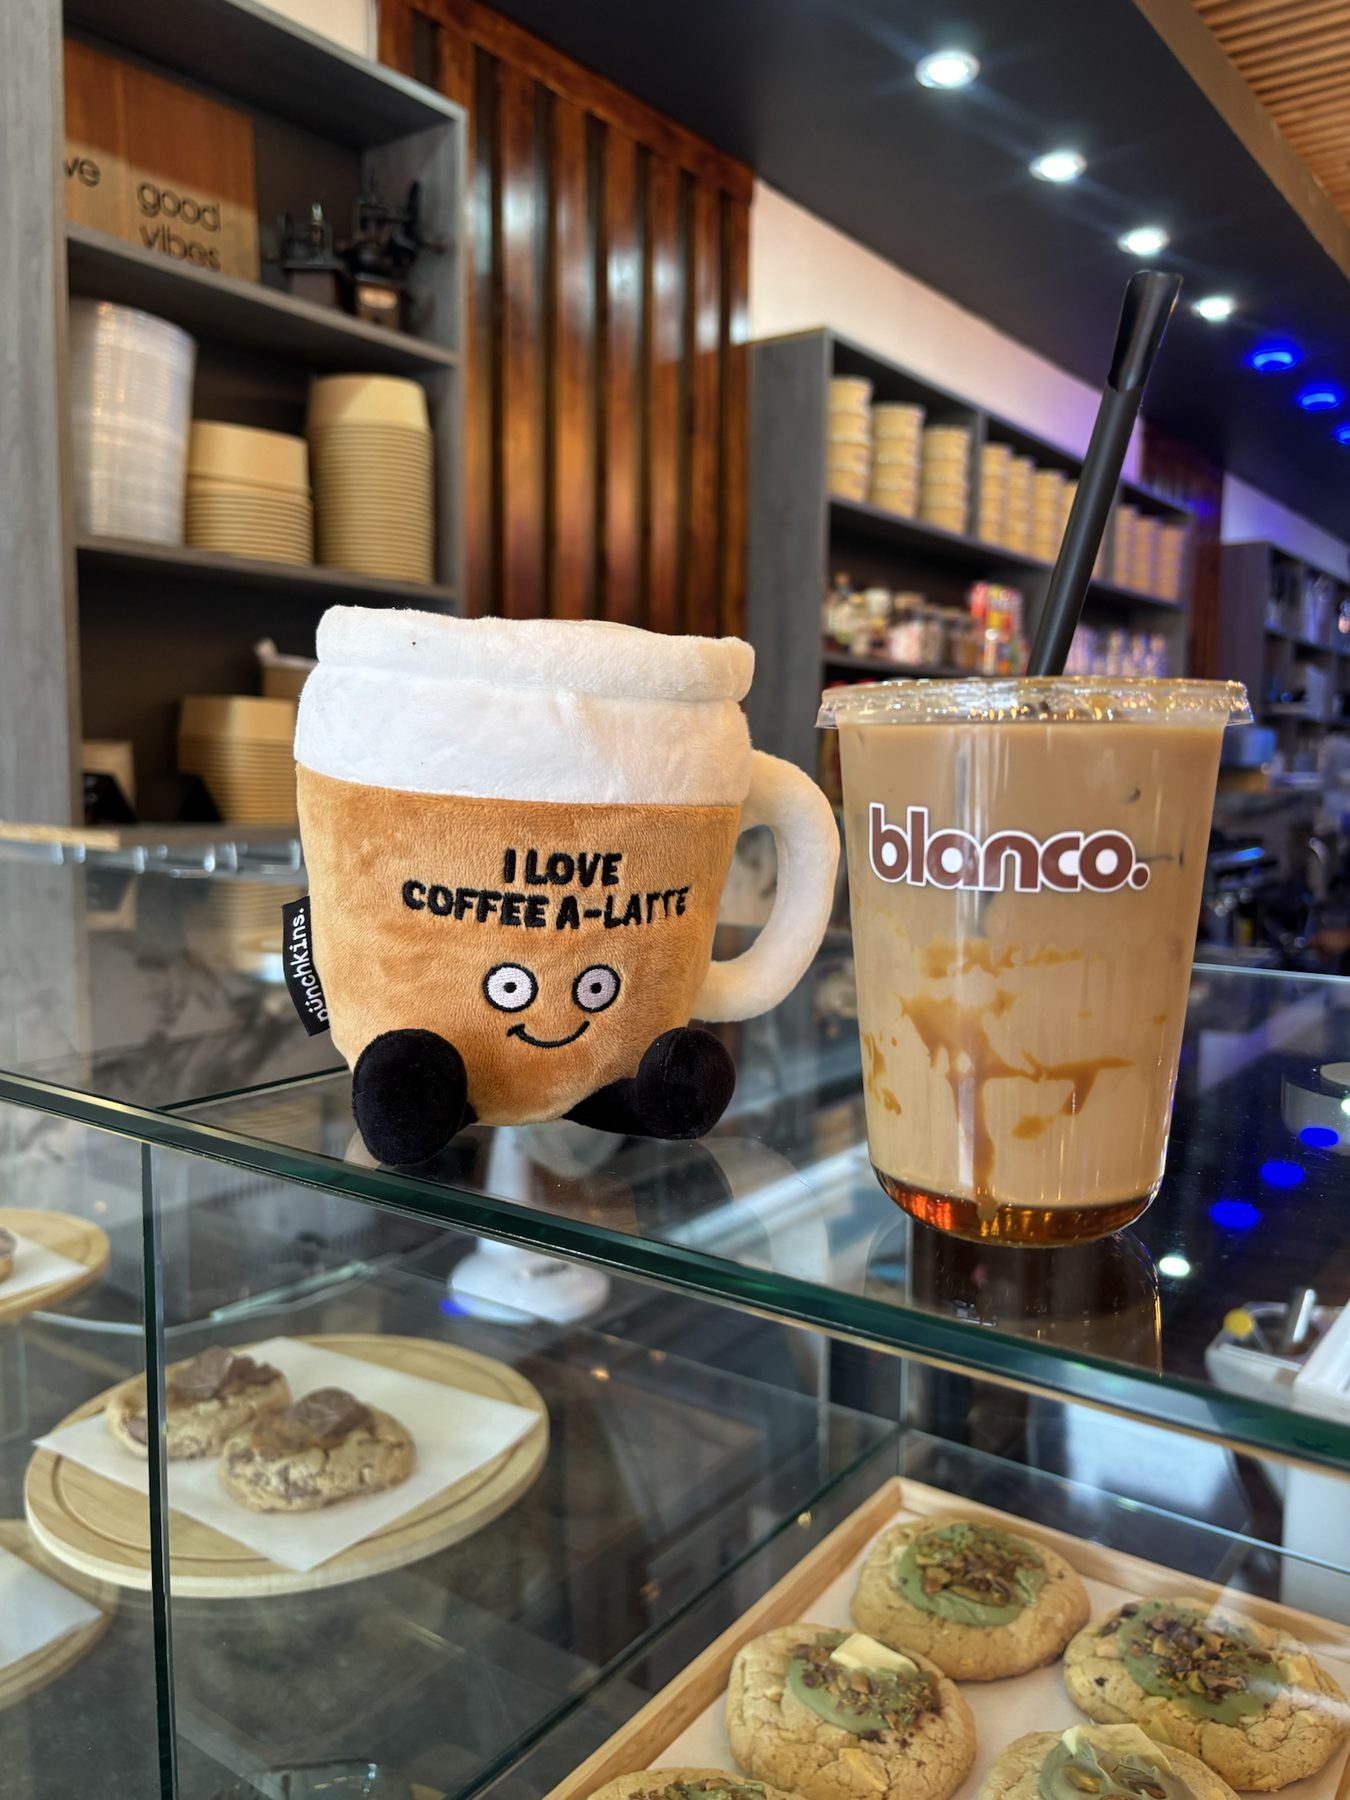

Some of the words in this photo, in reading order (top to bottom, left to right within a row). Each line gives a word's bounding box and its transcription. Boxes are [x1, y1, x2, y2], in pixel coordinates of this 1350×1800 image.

[137, 181, 221, 232] good
[138, 223, 221, 272] vibes
[504, 848, 517, 883] I
[525, 848, 623, 888] LOVE
[869, 802, 1150, 893] blanco.
[402, 879, 550, 928] COFFEE
[556, 886, 690, 930] A-LATTE
